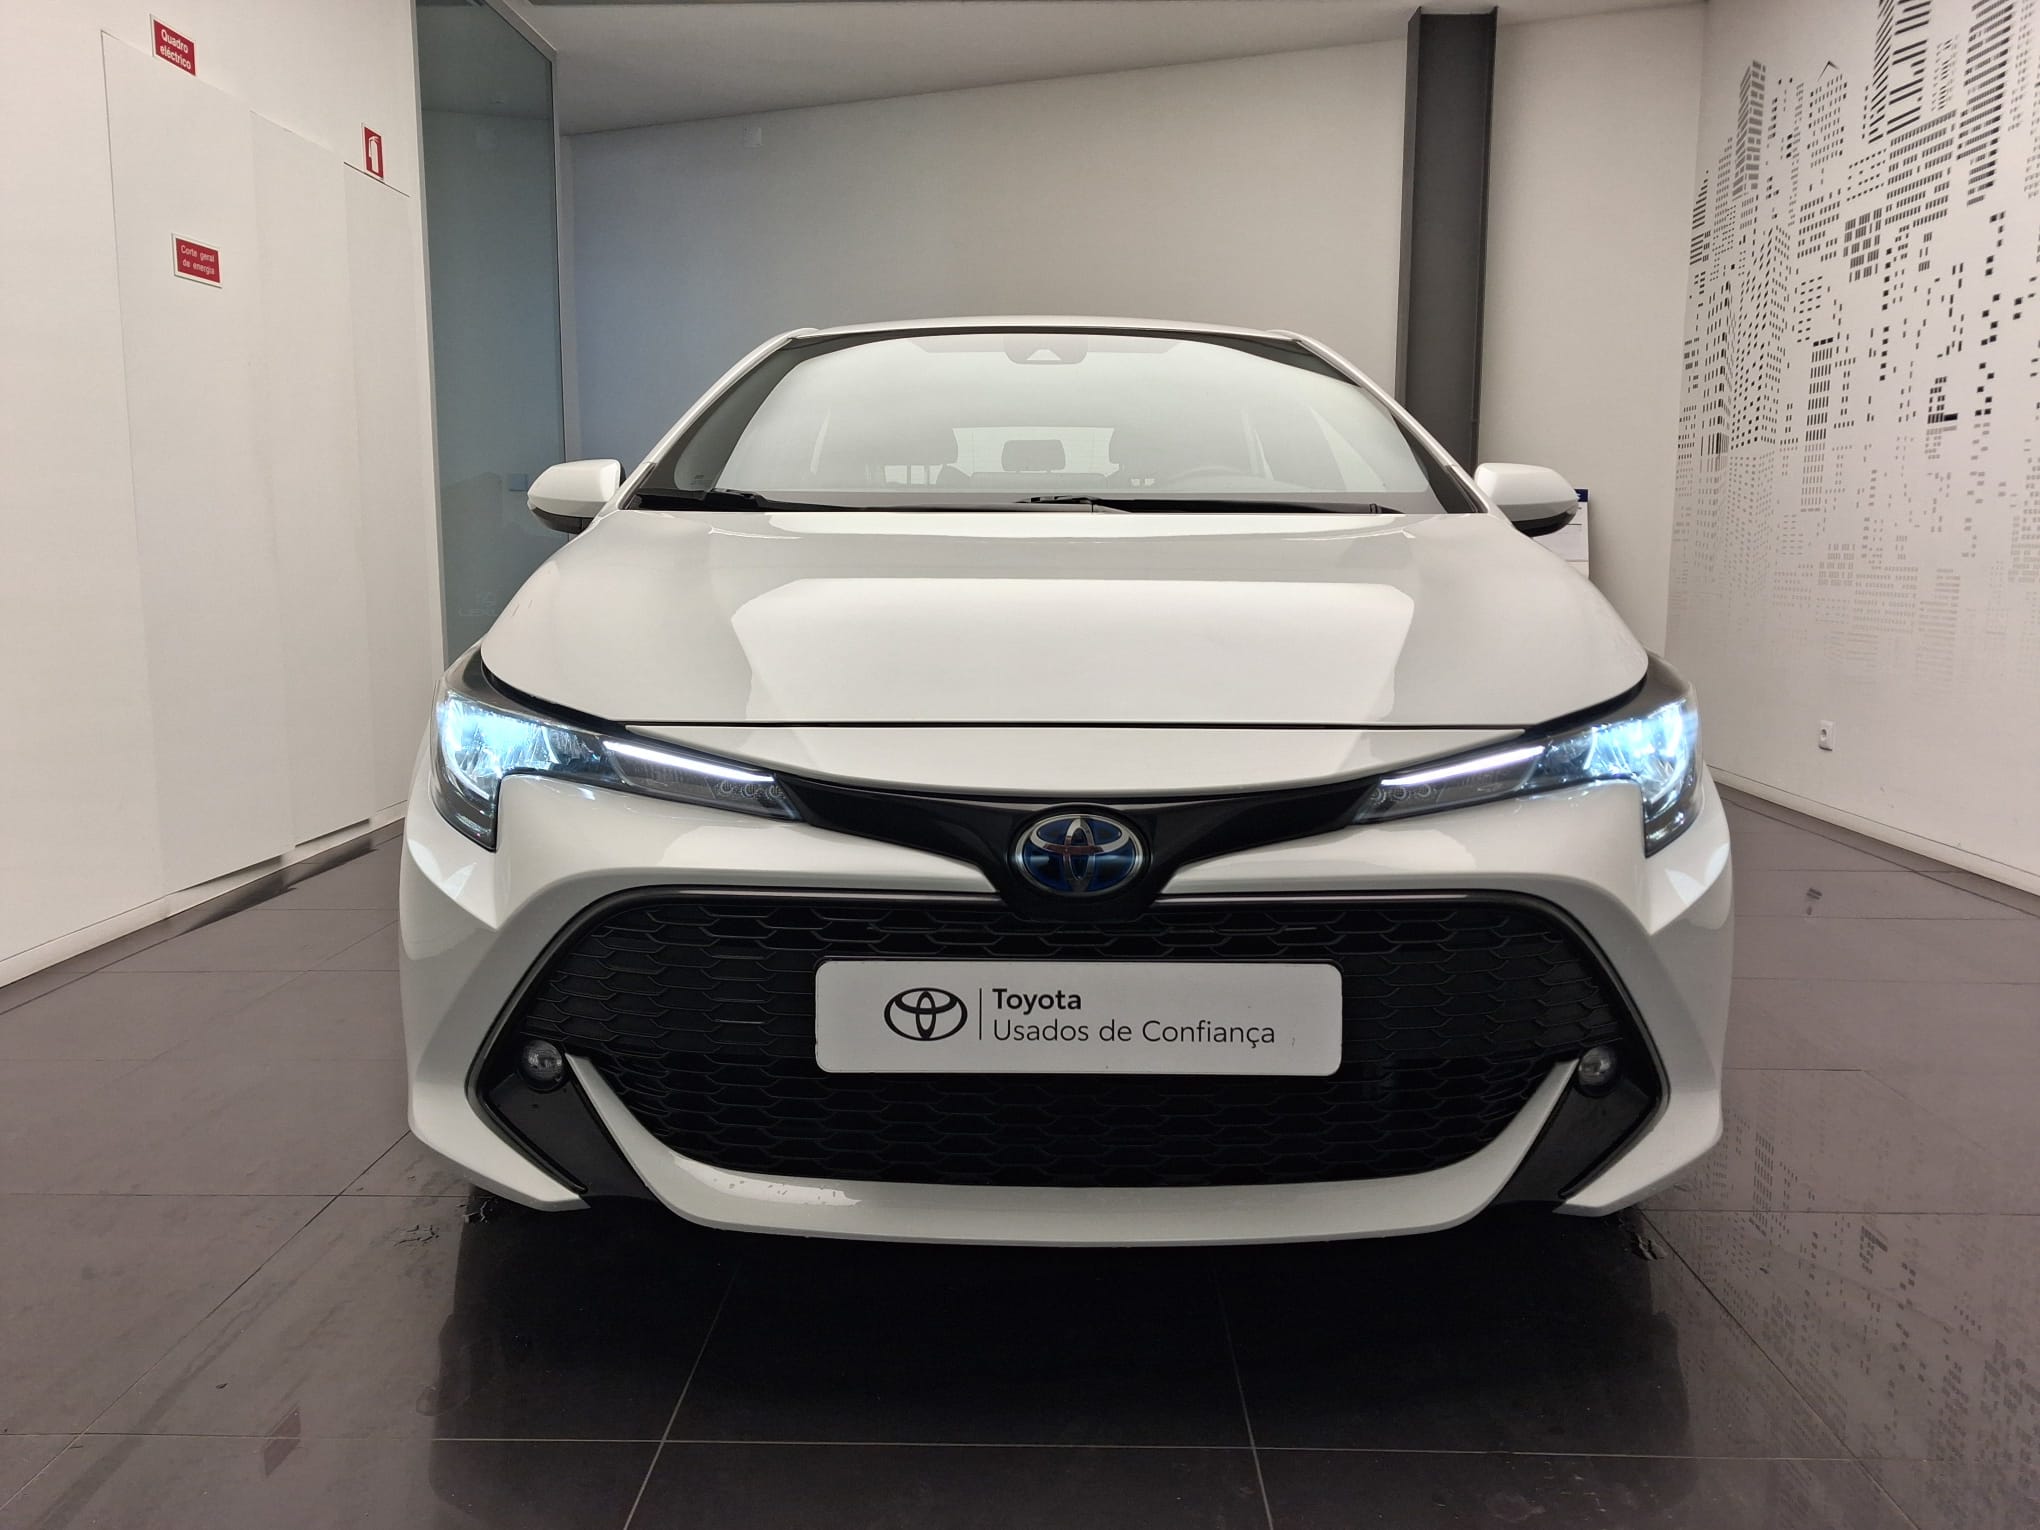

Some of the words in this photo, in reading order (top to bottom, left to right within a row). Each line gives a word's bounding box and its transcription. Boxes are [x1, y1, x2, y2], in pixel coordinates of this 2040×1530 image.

[161, 28, 189, 54] Quadro
[159, 45, 192, 70] eléctrico
[180, 244, 198, 258] Corte
[199, 252, 215, 262] geral
[182, 259, 191, 268] de
[192, 262, 215, 275] energia
[992, 988, 1082, 1015] Toyota
[994, 1018, 1089, 1041] Usados
[1098, 1018, 1133, 1042] de
[1142, 1020, 1275, 1049] Confiança
